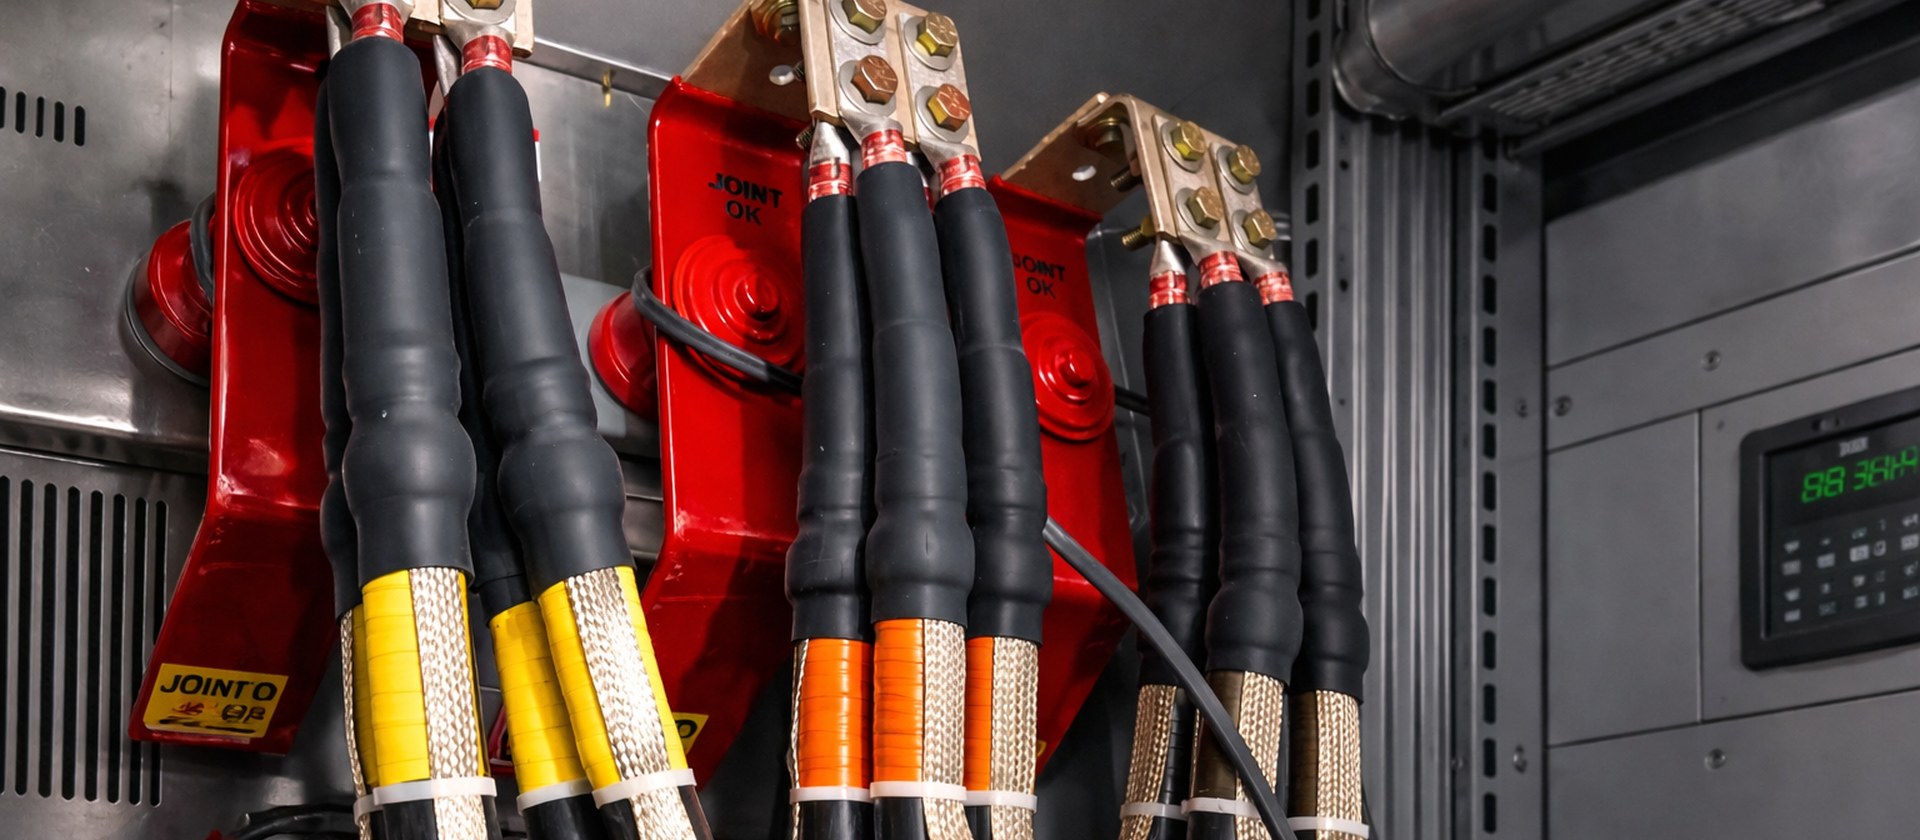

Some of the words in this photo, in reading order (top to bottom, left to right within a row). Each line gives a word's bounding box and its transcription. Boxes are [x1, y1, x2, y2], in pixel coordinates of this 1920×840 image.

[708, 172, 783, 208] JOINT
[726, 200, 762, 226] OK
[1026, 276, 1056, 299] OK
